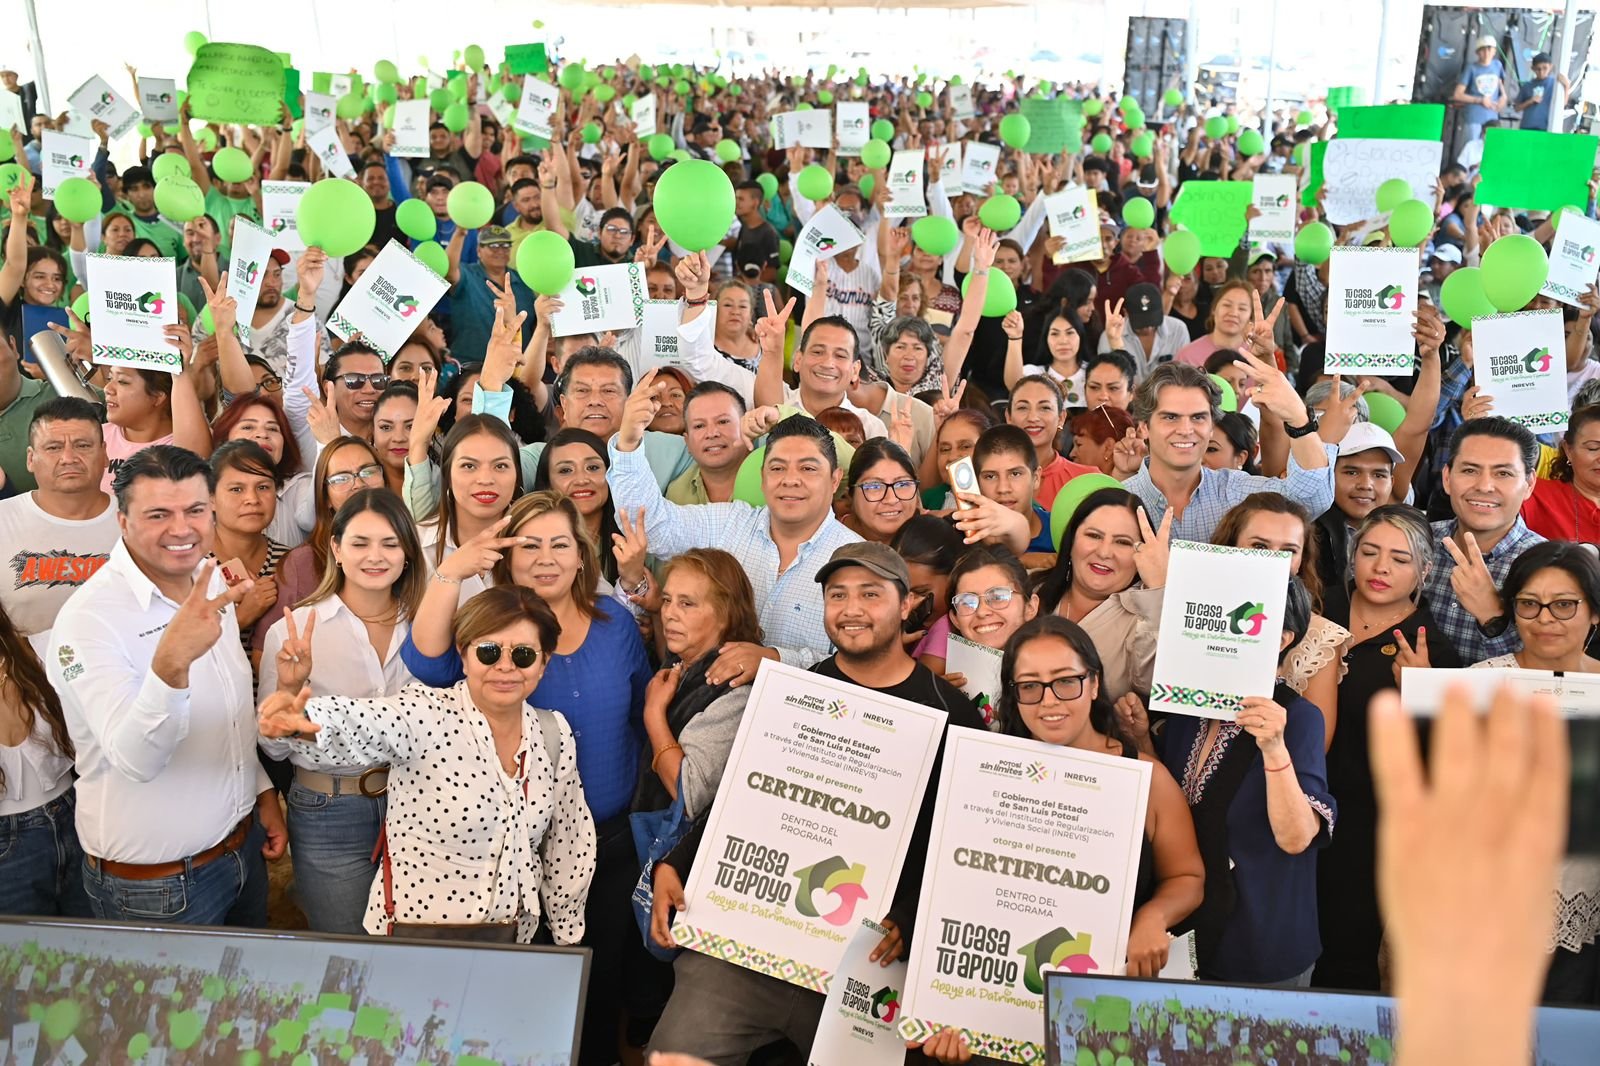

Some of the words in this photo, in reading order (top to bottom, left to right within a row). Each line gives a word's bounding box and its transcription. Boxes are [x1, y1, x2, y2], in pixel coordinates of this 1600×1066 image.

[21, 557, 107, 582] AWESO
[1207, 645, 1238, 654] INREVIS
[785, 695, 798, 704] sin
[863, 712, 894, 726] INREVIS
[797, 732, 808, 741] de
[809, 737, 825, 746] San
[826, 741, 844, 752] Luis
[845, 746, 872, 760] Potosí
[800, 724, 837, 741] Gobierno
[837, 736, 851, 745] del
[852, 740, 881, 754] Estado
[770, 732, 792, 744] través
[792, 739, 805, 748] del
[805, 742, 837, 758] Instituto
[837, 752, 847, 760] de
[848, 756, 902, 778] Regularización
[788, 746, 819, 762] Vivienda
[820, 756, 842, 768] Social
[843, 762, 878, 780] (INREVIS)
[980, 762, 993, 770] sin
[786, 765, 814, 781] otorga
[816, 774, 825, 782] el
[825, 777, 863, 794] presente
[1064, 772, 1097, 784] INREVIS
[746, 771, 891, 830] CERTIFICADO
[992, 790, 1000, 798] El
[1001, 792, 1040, 805] Gobierno
[1042, 800, 1056, 808] del
[1057, 802, 1088, 815] Estado
[1012, 803, 1029, 812] San
[1031, 807, 1049, 817] Luis
[1051, 810, 1079, 822] Potosí
[781, 812, 819, 832] DENTRO
[820, 826, 839, 837] DEL
[970, 804, 994, 815] través
[995, 808, 1008, 817] del
[1009, 812, 1042, 824] Instituto
[1044, 818, 1055, 827] de
[1056, 820, 1115, 838] Regularización
[991, 817, 1026, 830] Vivienda
[1027, 824, 1051, 834] Social
[1052, 829, 1089, 843] (INREVIS)
[780, 823, 833, 846] PROGRAMA
[993, 837, 1023, 850] otorga
[1025, 843, 1034, 851] el
[1035, 845, 1077, 859] presente
[953, 847, 1110, 894] CERTIFICADO
[995, 887, 1037, 904] DENTRO
[1038, 897, 1058, 908] DEL
[996, 899, 1054, 918] PROGRAMA
[706, 890, 737, 912] Apoyo
[738, 901, 749, 911] al
[805, 920, 847, 944] Familiar
[930, 979, 964, 1000] Apoyo
[966, 986, 976, 997] al
[852, 1025, 874, 1038] INREVIS
